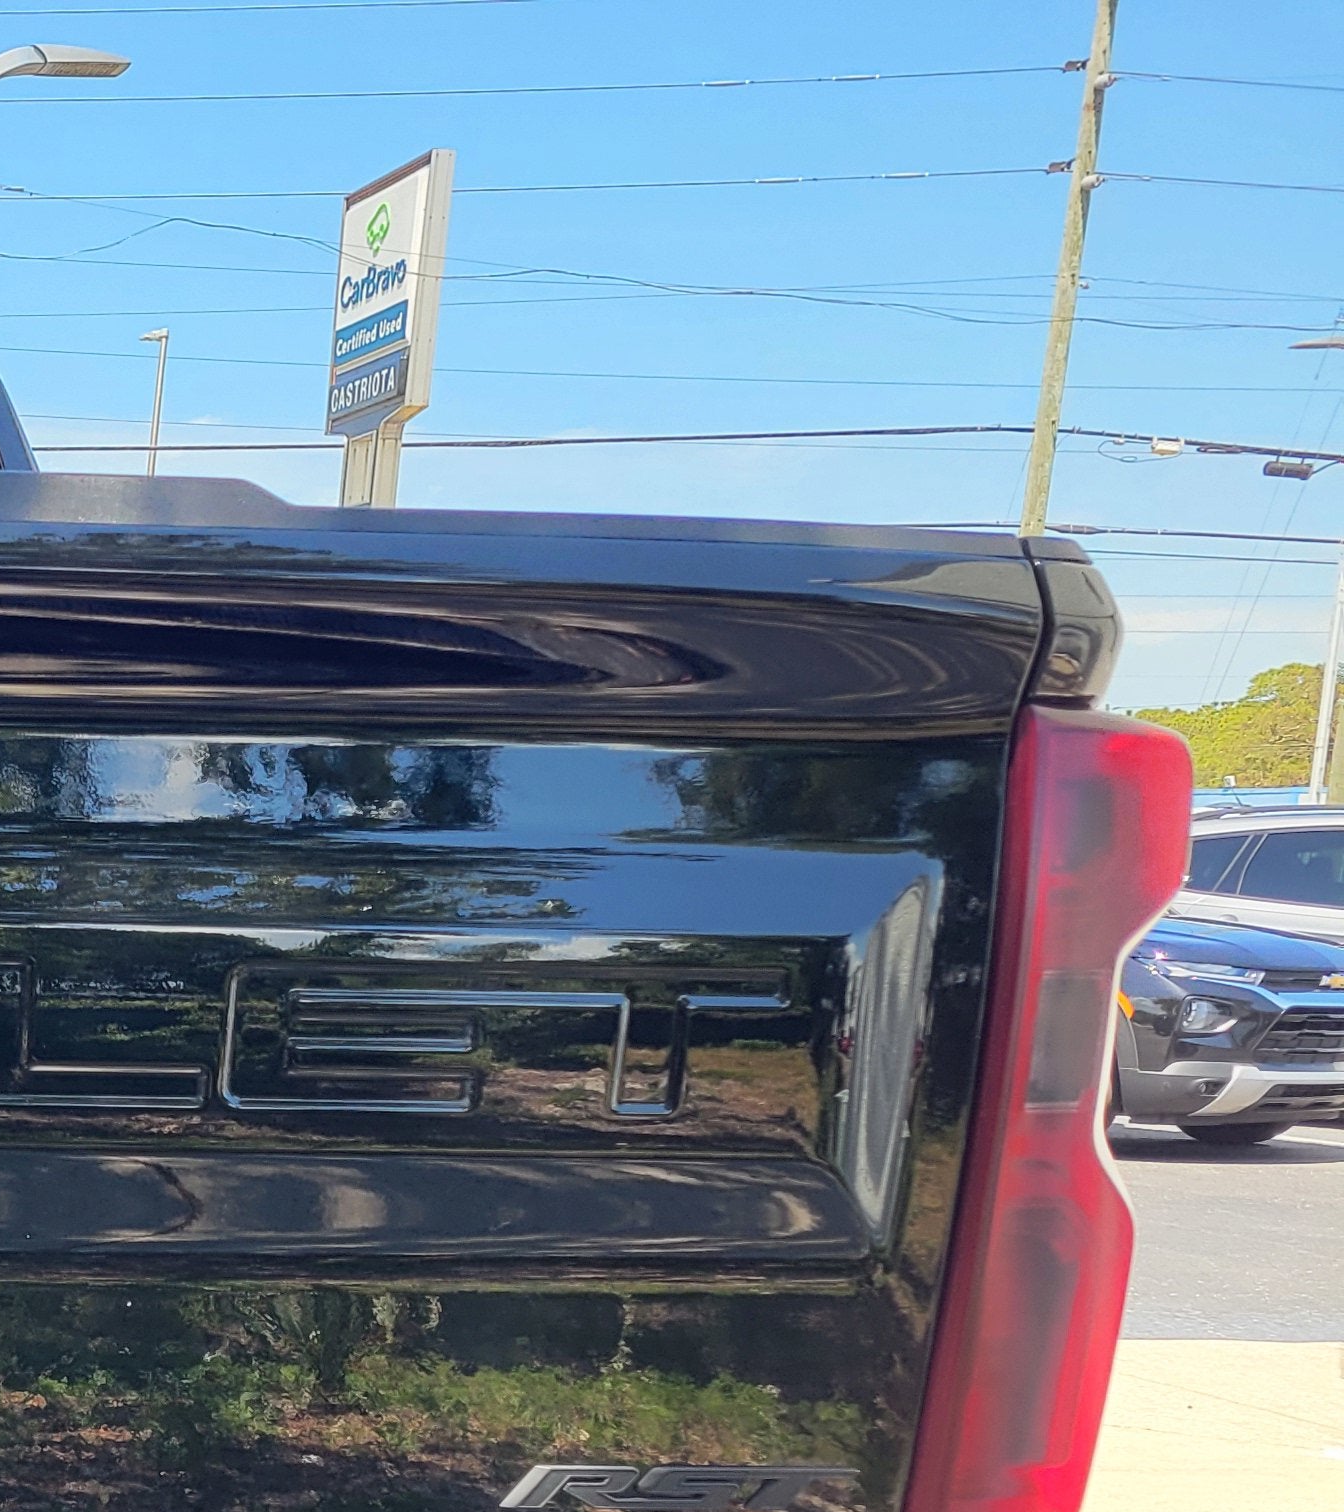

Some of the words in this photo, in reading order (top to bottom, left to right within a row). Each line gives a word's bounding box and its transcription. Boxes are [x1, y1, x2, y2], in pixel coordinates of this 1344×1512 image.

[340, 258, 407, 309] CarBravo
[336, 323, 378, 357] Certified
[379, 312, 404, 338] Used
[331, 366, 395, 412] CASTRIOTA
[498, 1463, 862, 1511] RST
